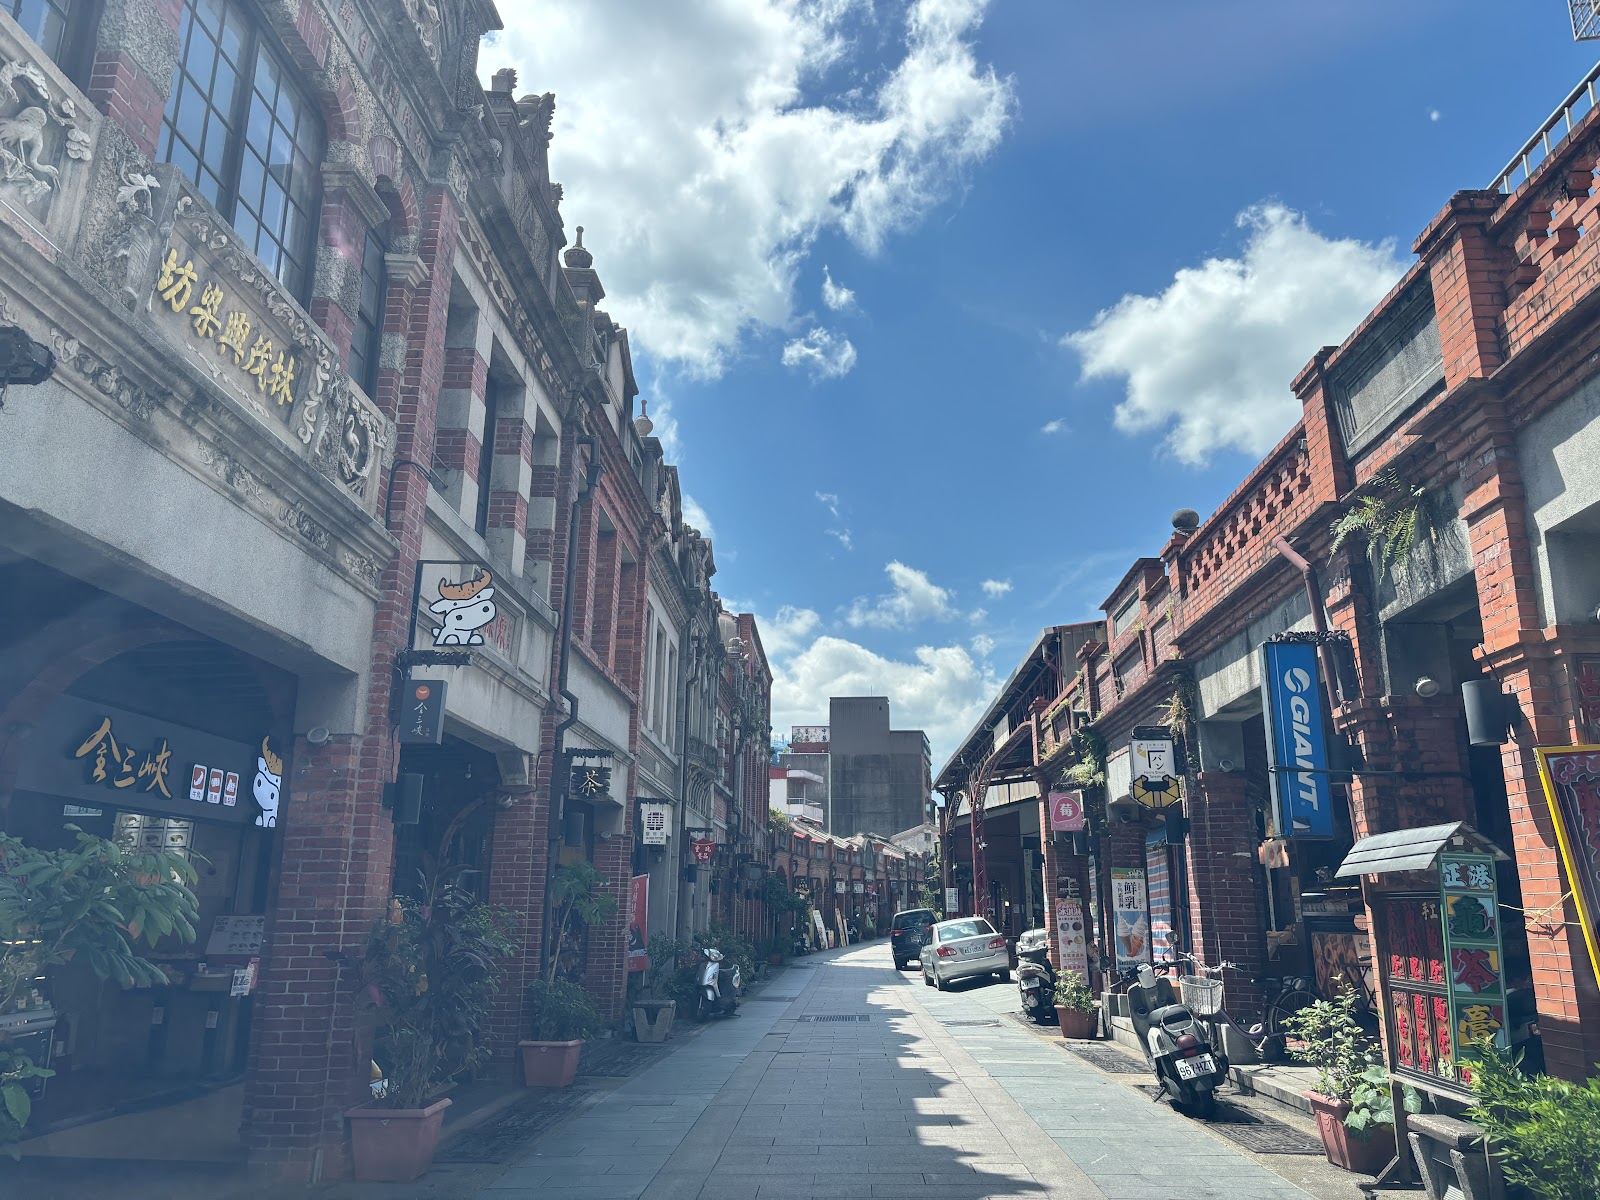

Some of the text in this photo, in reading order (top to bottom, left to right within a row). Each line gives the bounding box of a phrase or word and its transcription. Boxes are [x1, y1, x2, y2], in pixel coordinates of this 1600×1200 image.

[411, 702, 424, 737] 金三峽
[75, 717, 172, 799] 金三峽
[1291, 695, 1319, 812] GIANT
[579, 769, 604, 797] 茶
[1442, 863, 1495, 890] 正港
[1124, 881, 1139, 910] 鮮乳
